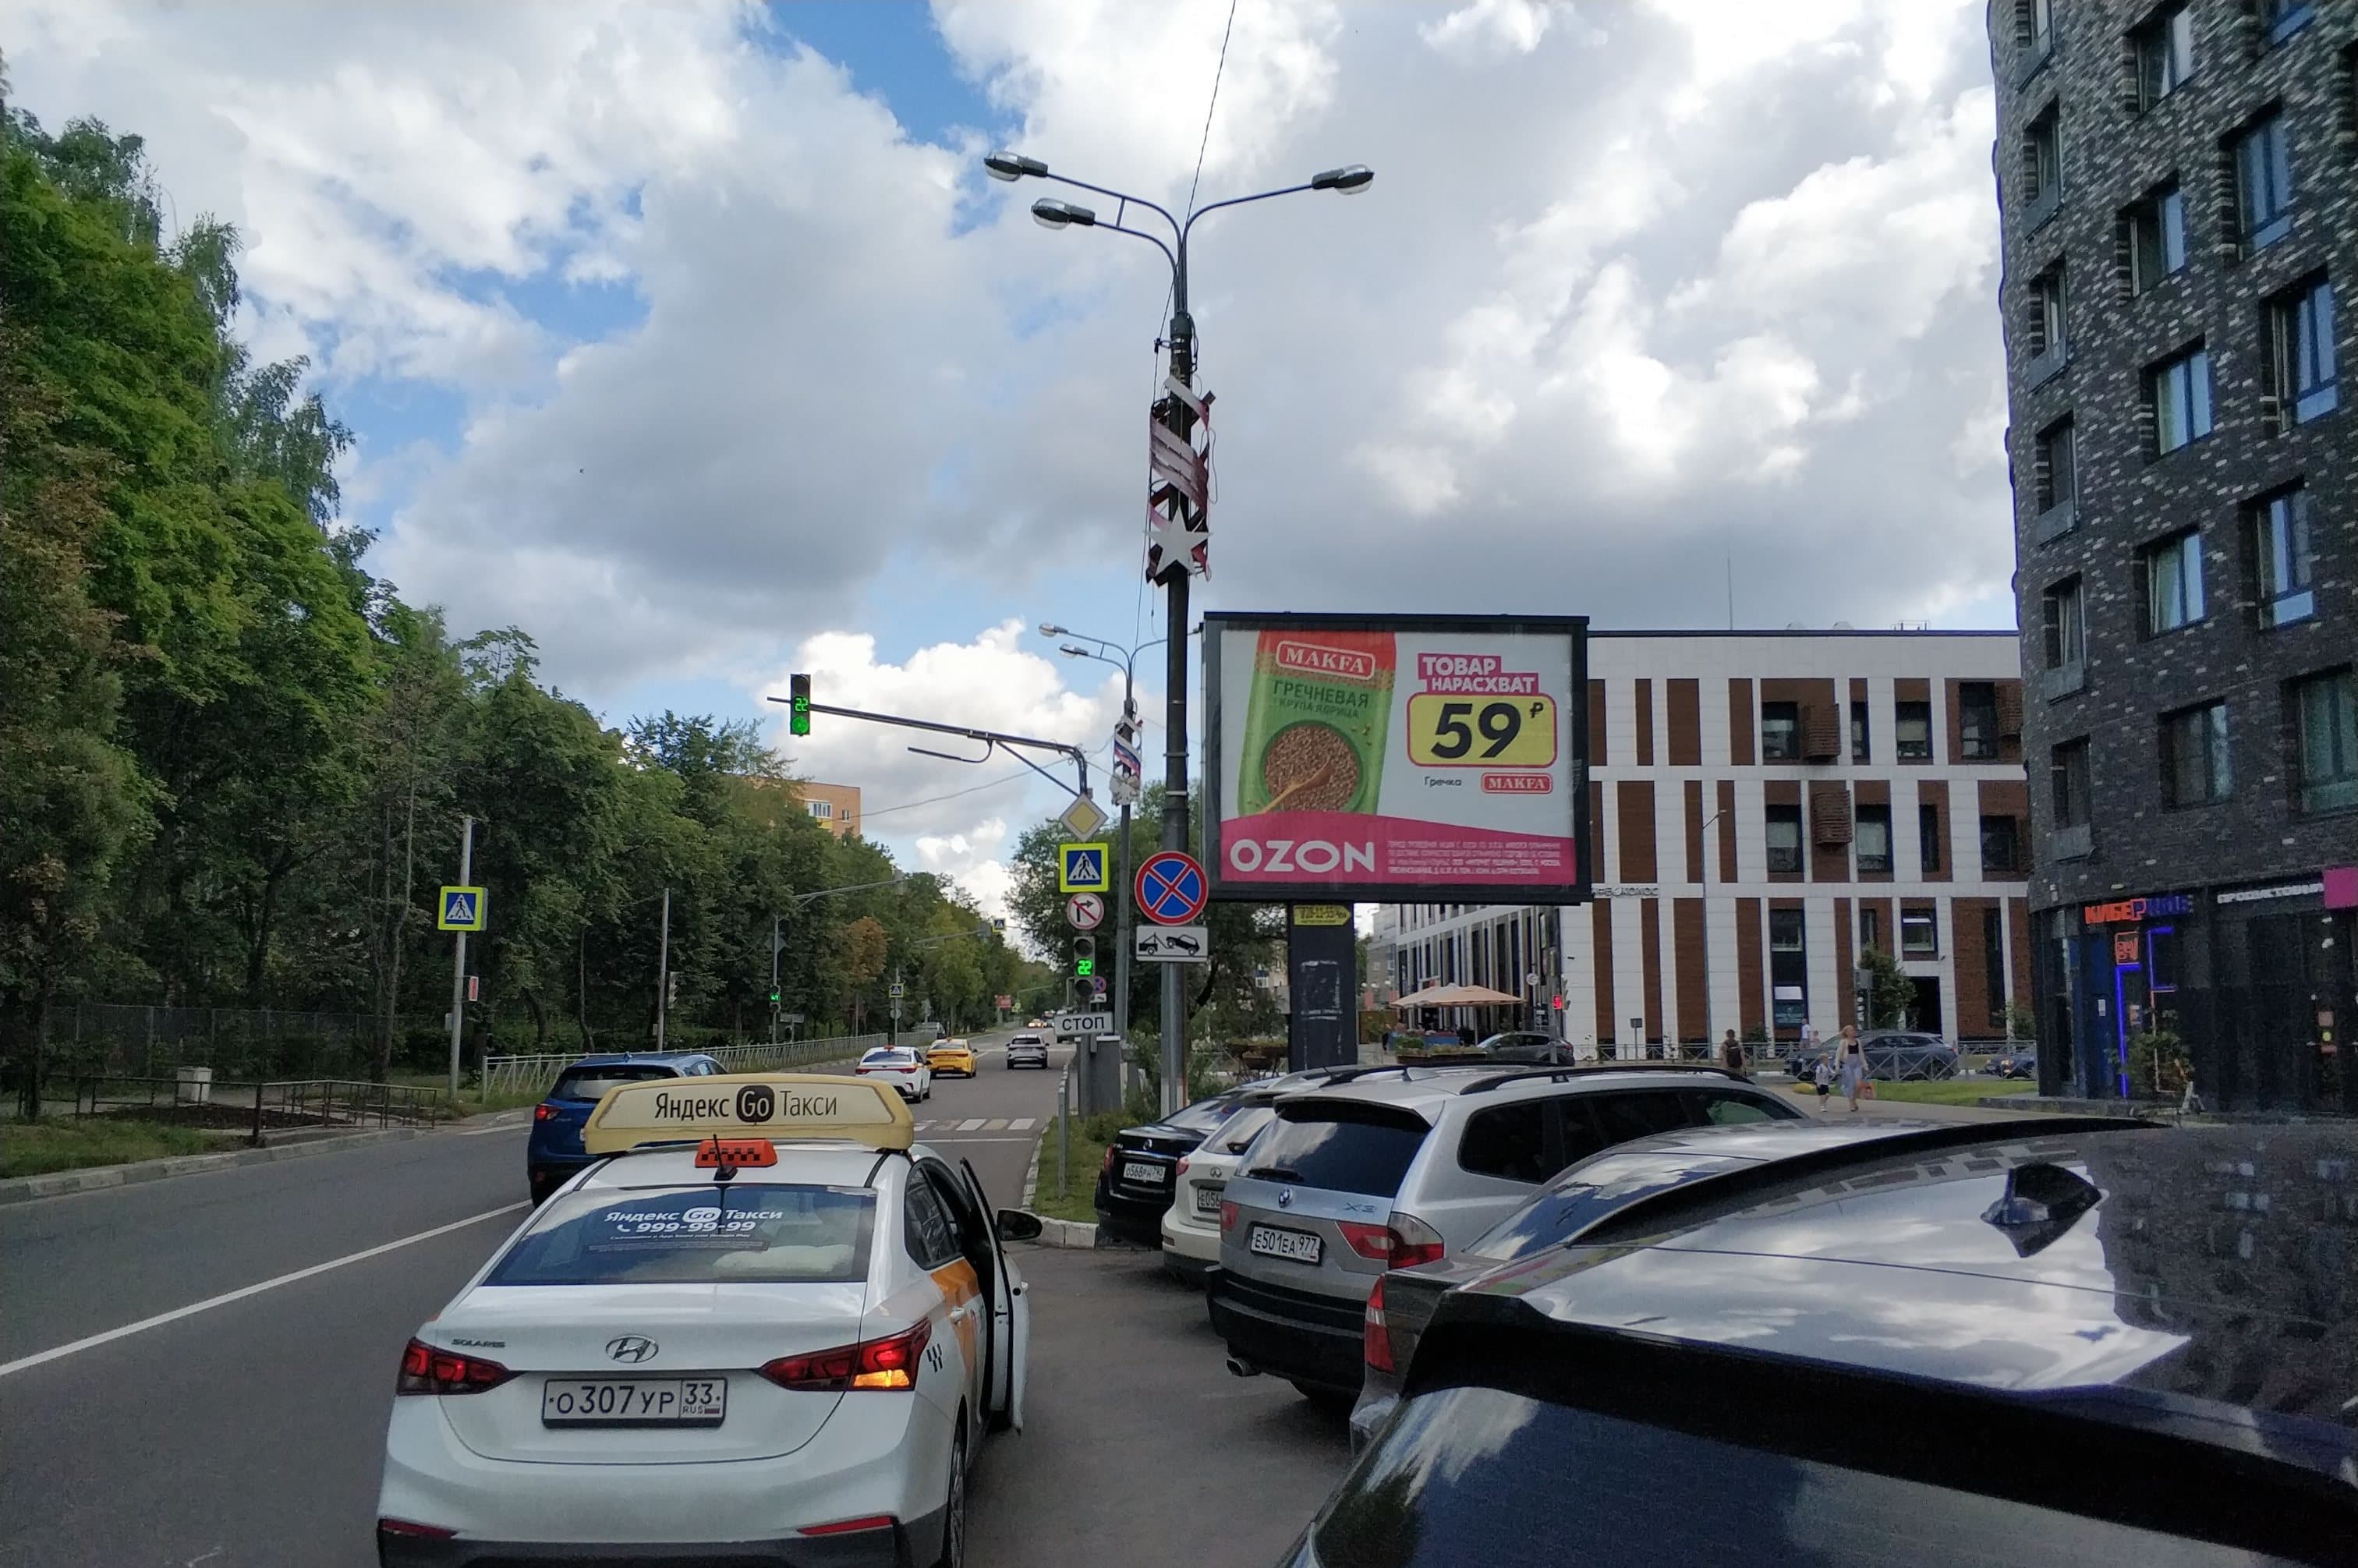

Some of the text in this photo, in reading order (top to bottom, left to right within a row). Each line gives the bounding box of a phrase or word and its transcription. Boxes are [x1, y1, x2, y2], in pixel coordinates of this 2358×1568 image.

[1285, 647, 1365, 674] MAKFA
[1422, 657, 1496, 676] ТОВАР
[1432, 677, 1535, 693] НАРАСХВАТ
[1273, 680, 1368, 709] ГРЕЧНЕВАЯ
[795, 698, 808, 711] 22
[1424, 776, 1462, 788] Гречка
[1230, 839, 1375, 872] OZON
[1077, 960, 1092, 975] 22
[1062, 1017, 1105, 1031] СТОП
[655, 1090, 837, 1121] Яндекс Go Такси
[1345, 1202, 1376, 1213] X3
[604, 1211, 680, 1222] Яндекс
[726, 1209, 782, 1219] Такси
[636, 1222, 756, 1232] 999-99-99
[1255, 1230, 1316, 1255] Е501ЕА 977
[451, 1338, 505, 1347] SOLARIS
[557, 1384, 713, 1414] О307УР 33
